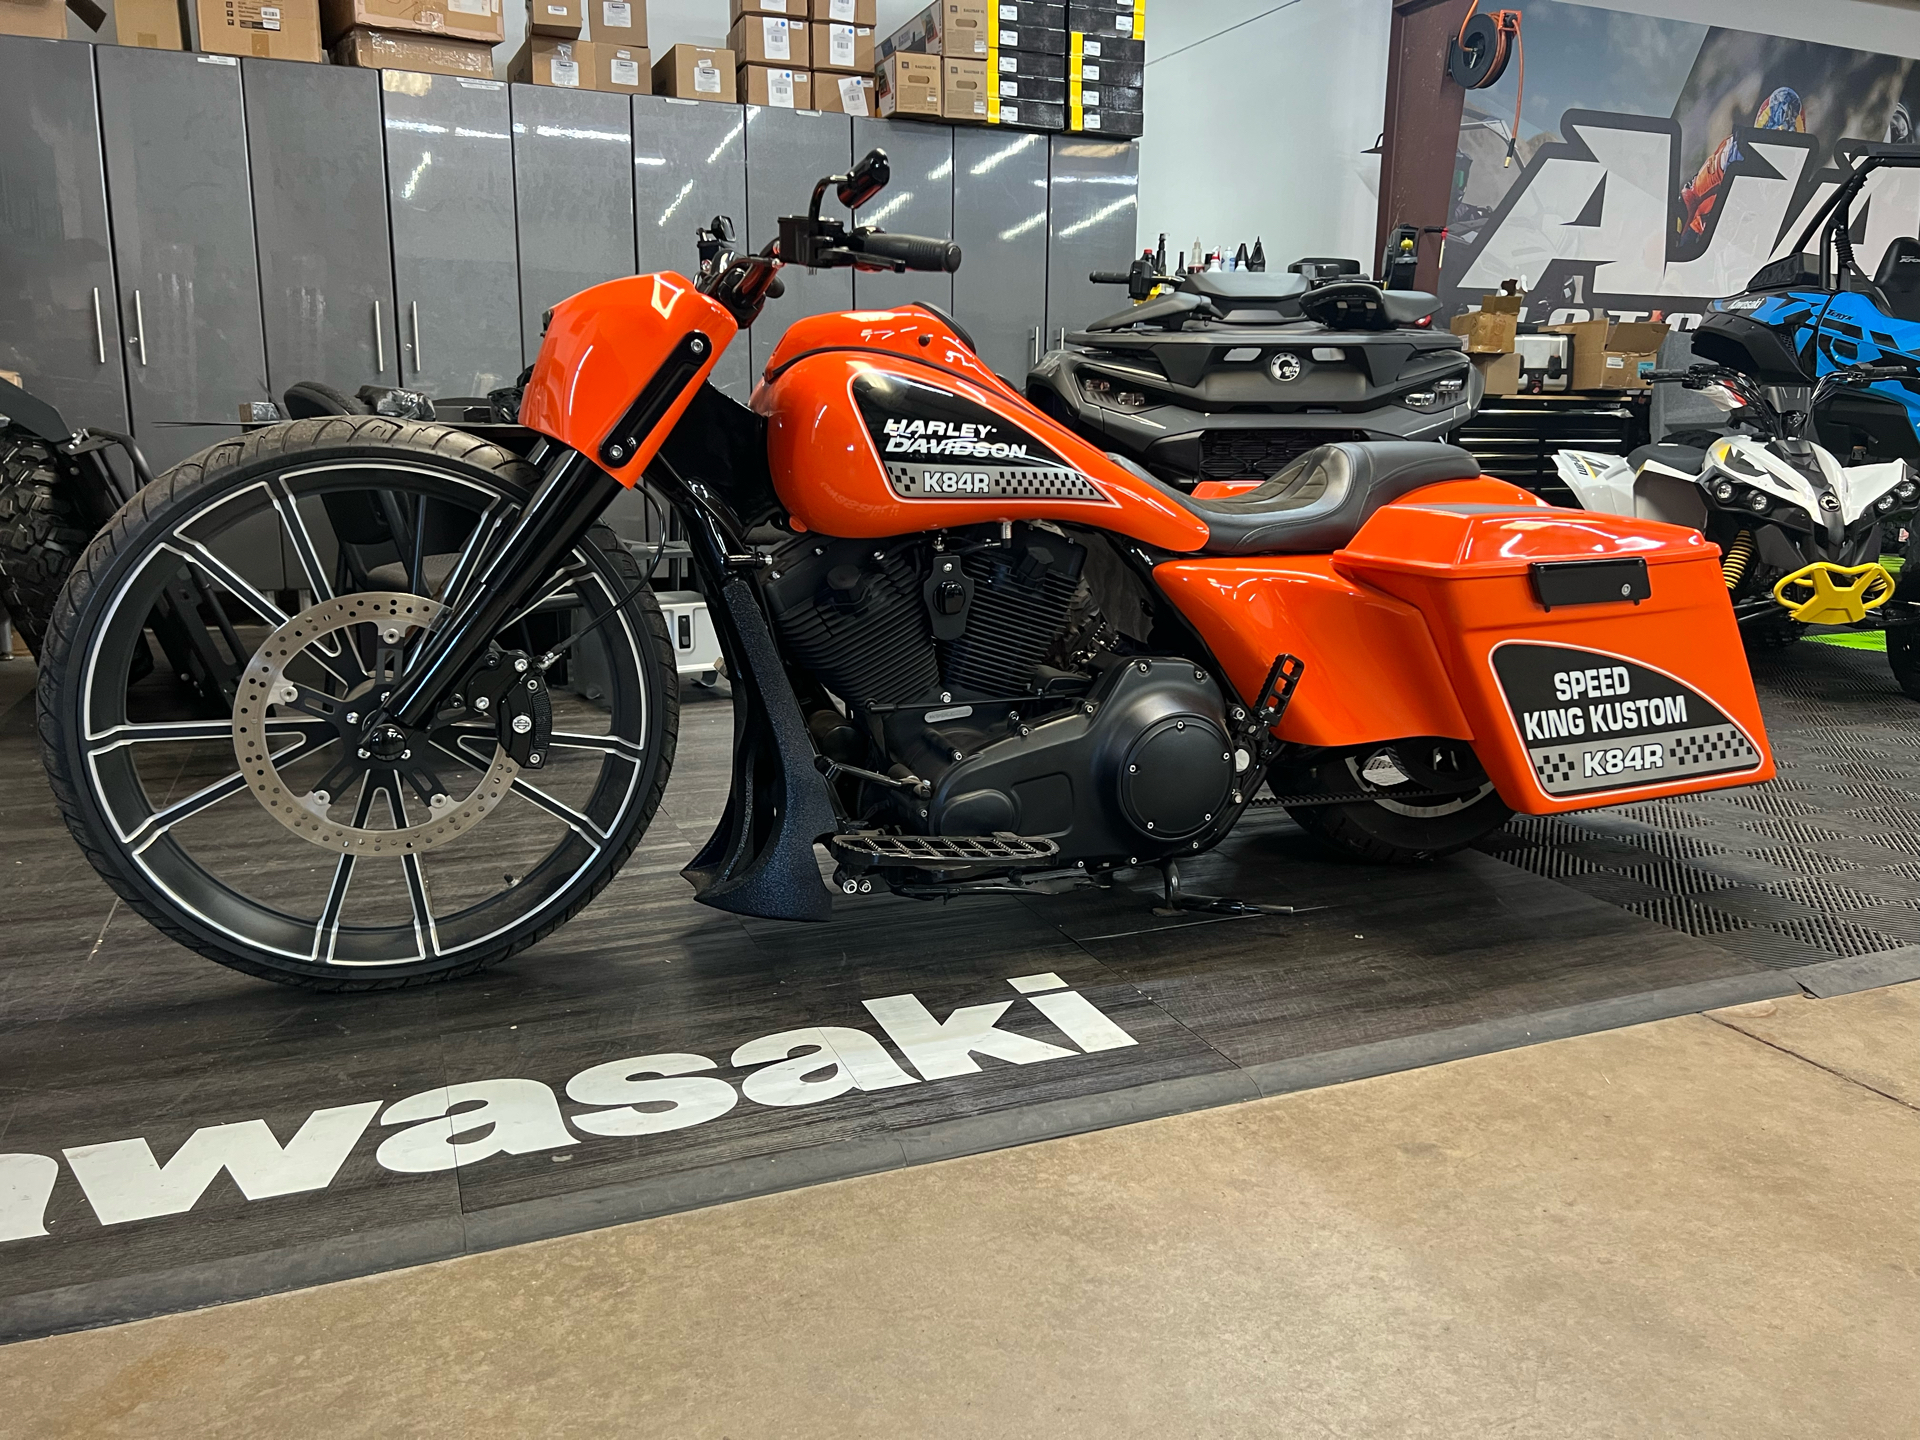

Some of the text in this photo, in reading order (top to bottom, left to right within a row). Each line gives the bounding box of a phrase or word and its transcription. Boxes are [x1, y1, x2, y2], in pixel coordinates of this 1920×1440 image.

[885, 437, 1027, 459] DAVIDSON
[923, 471, 990, 494] K84R
[1553, 666, 1631, 701] SPEED
[1523, 695, 1688, 741] KING KUSTOM
[1583, 743, 1664, 779] K84R
[0, 972, 1139, 1242] wasaki
